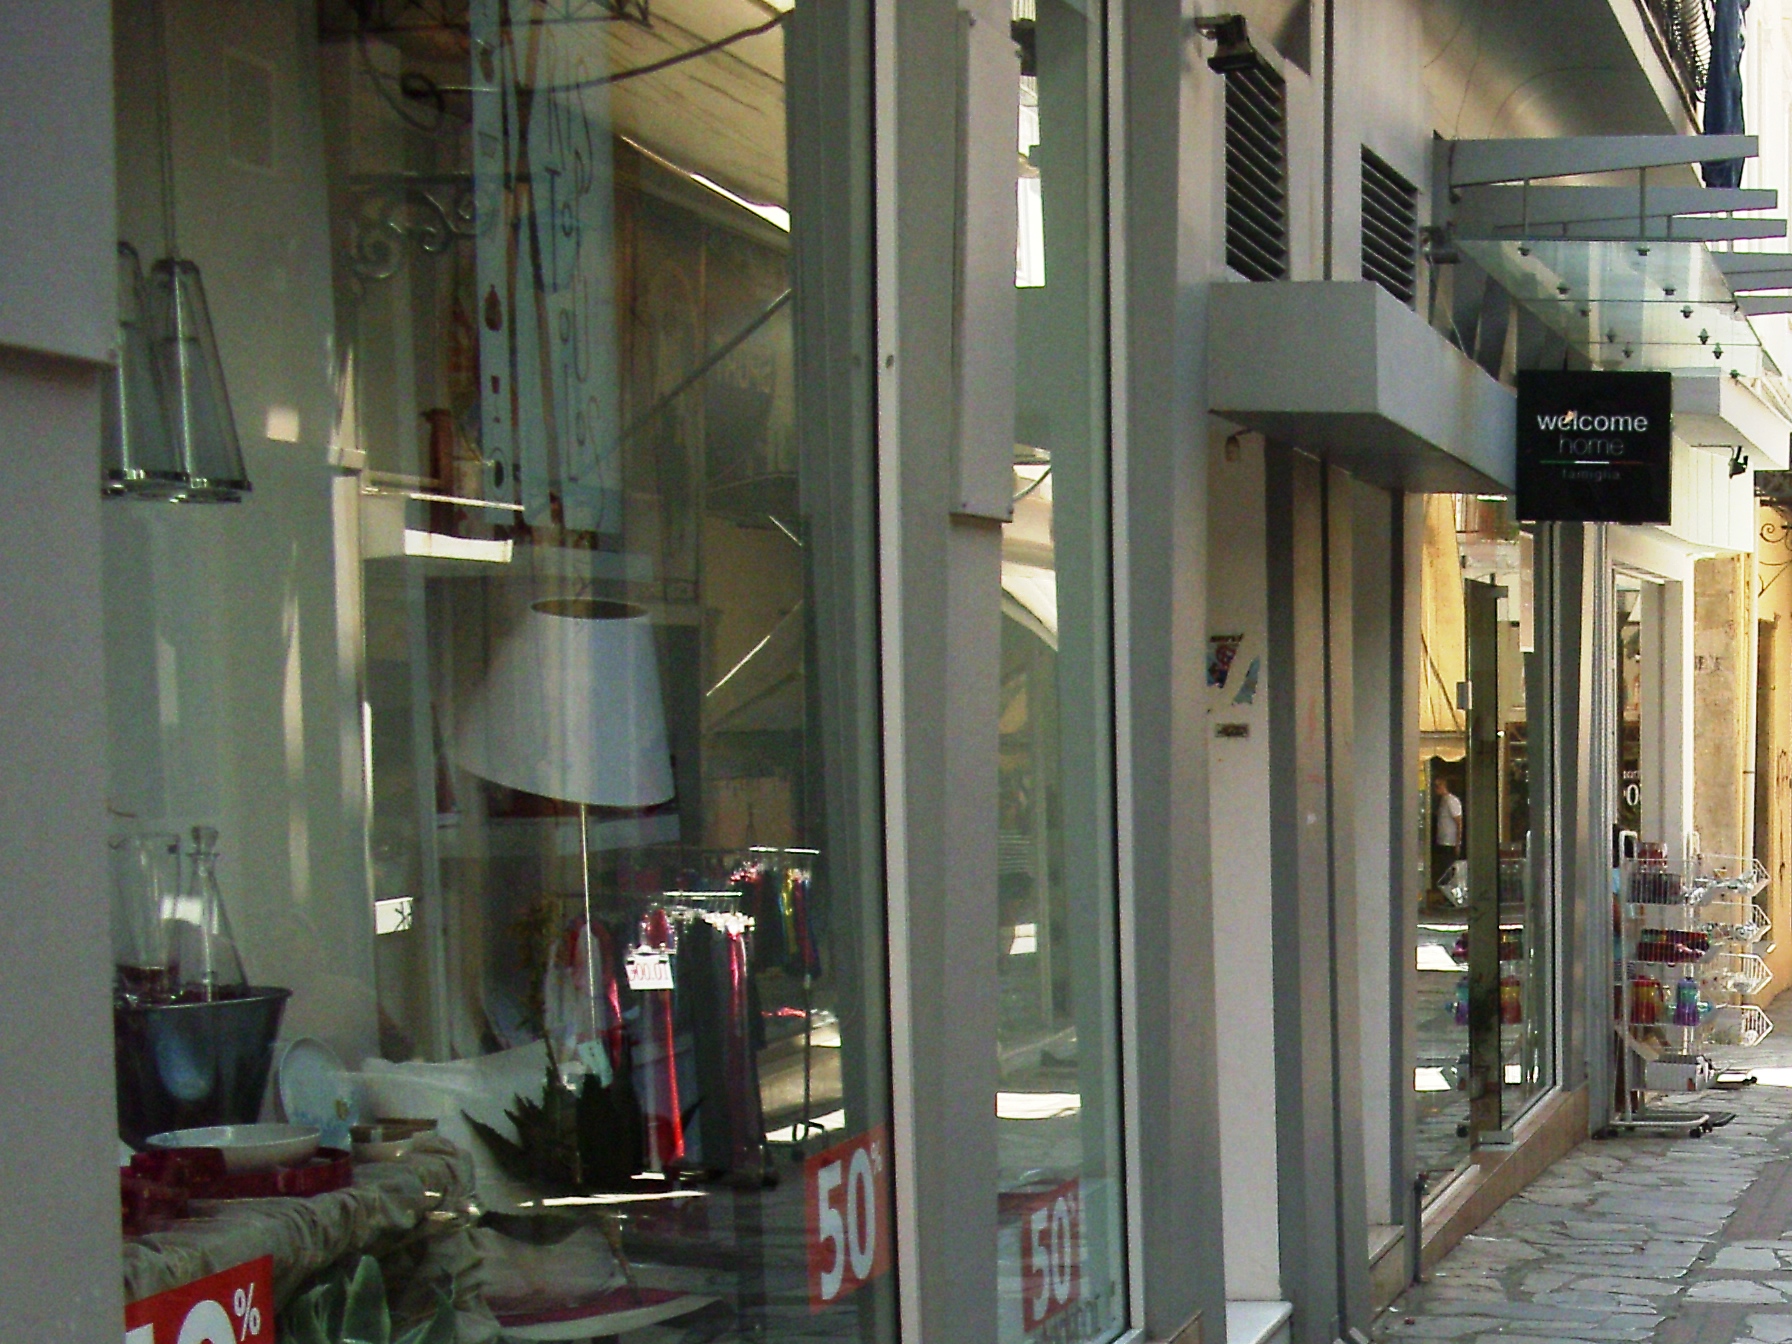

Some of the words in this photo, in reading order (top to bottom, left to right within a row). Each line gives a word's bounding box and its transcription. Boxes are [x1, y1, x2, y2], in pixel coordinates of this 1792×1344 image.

[1537, 410, 1648, 432] welcome
[1559, 435, 1624, 456] home
[818, 1140, 883, 1300] 50%
